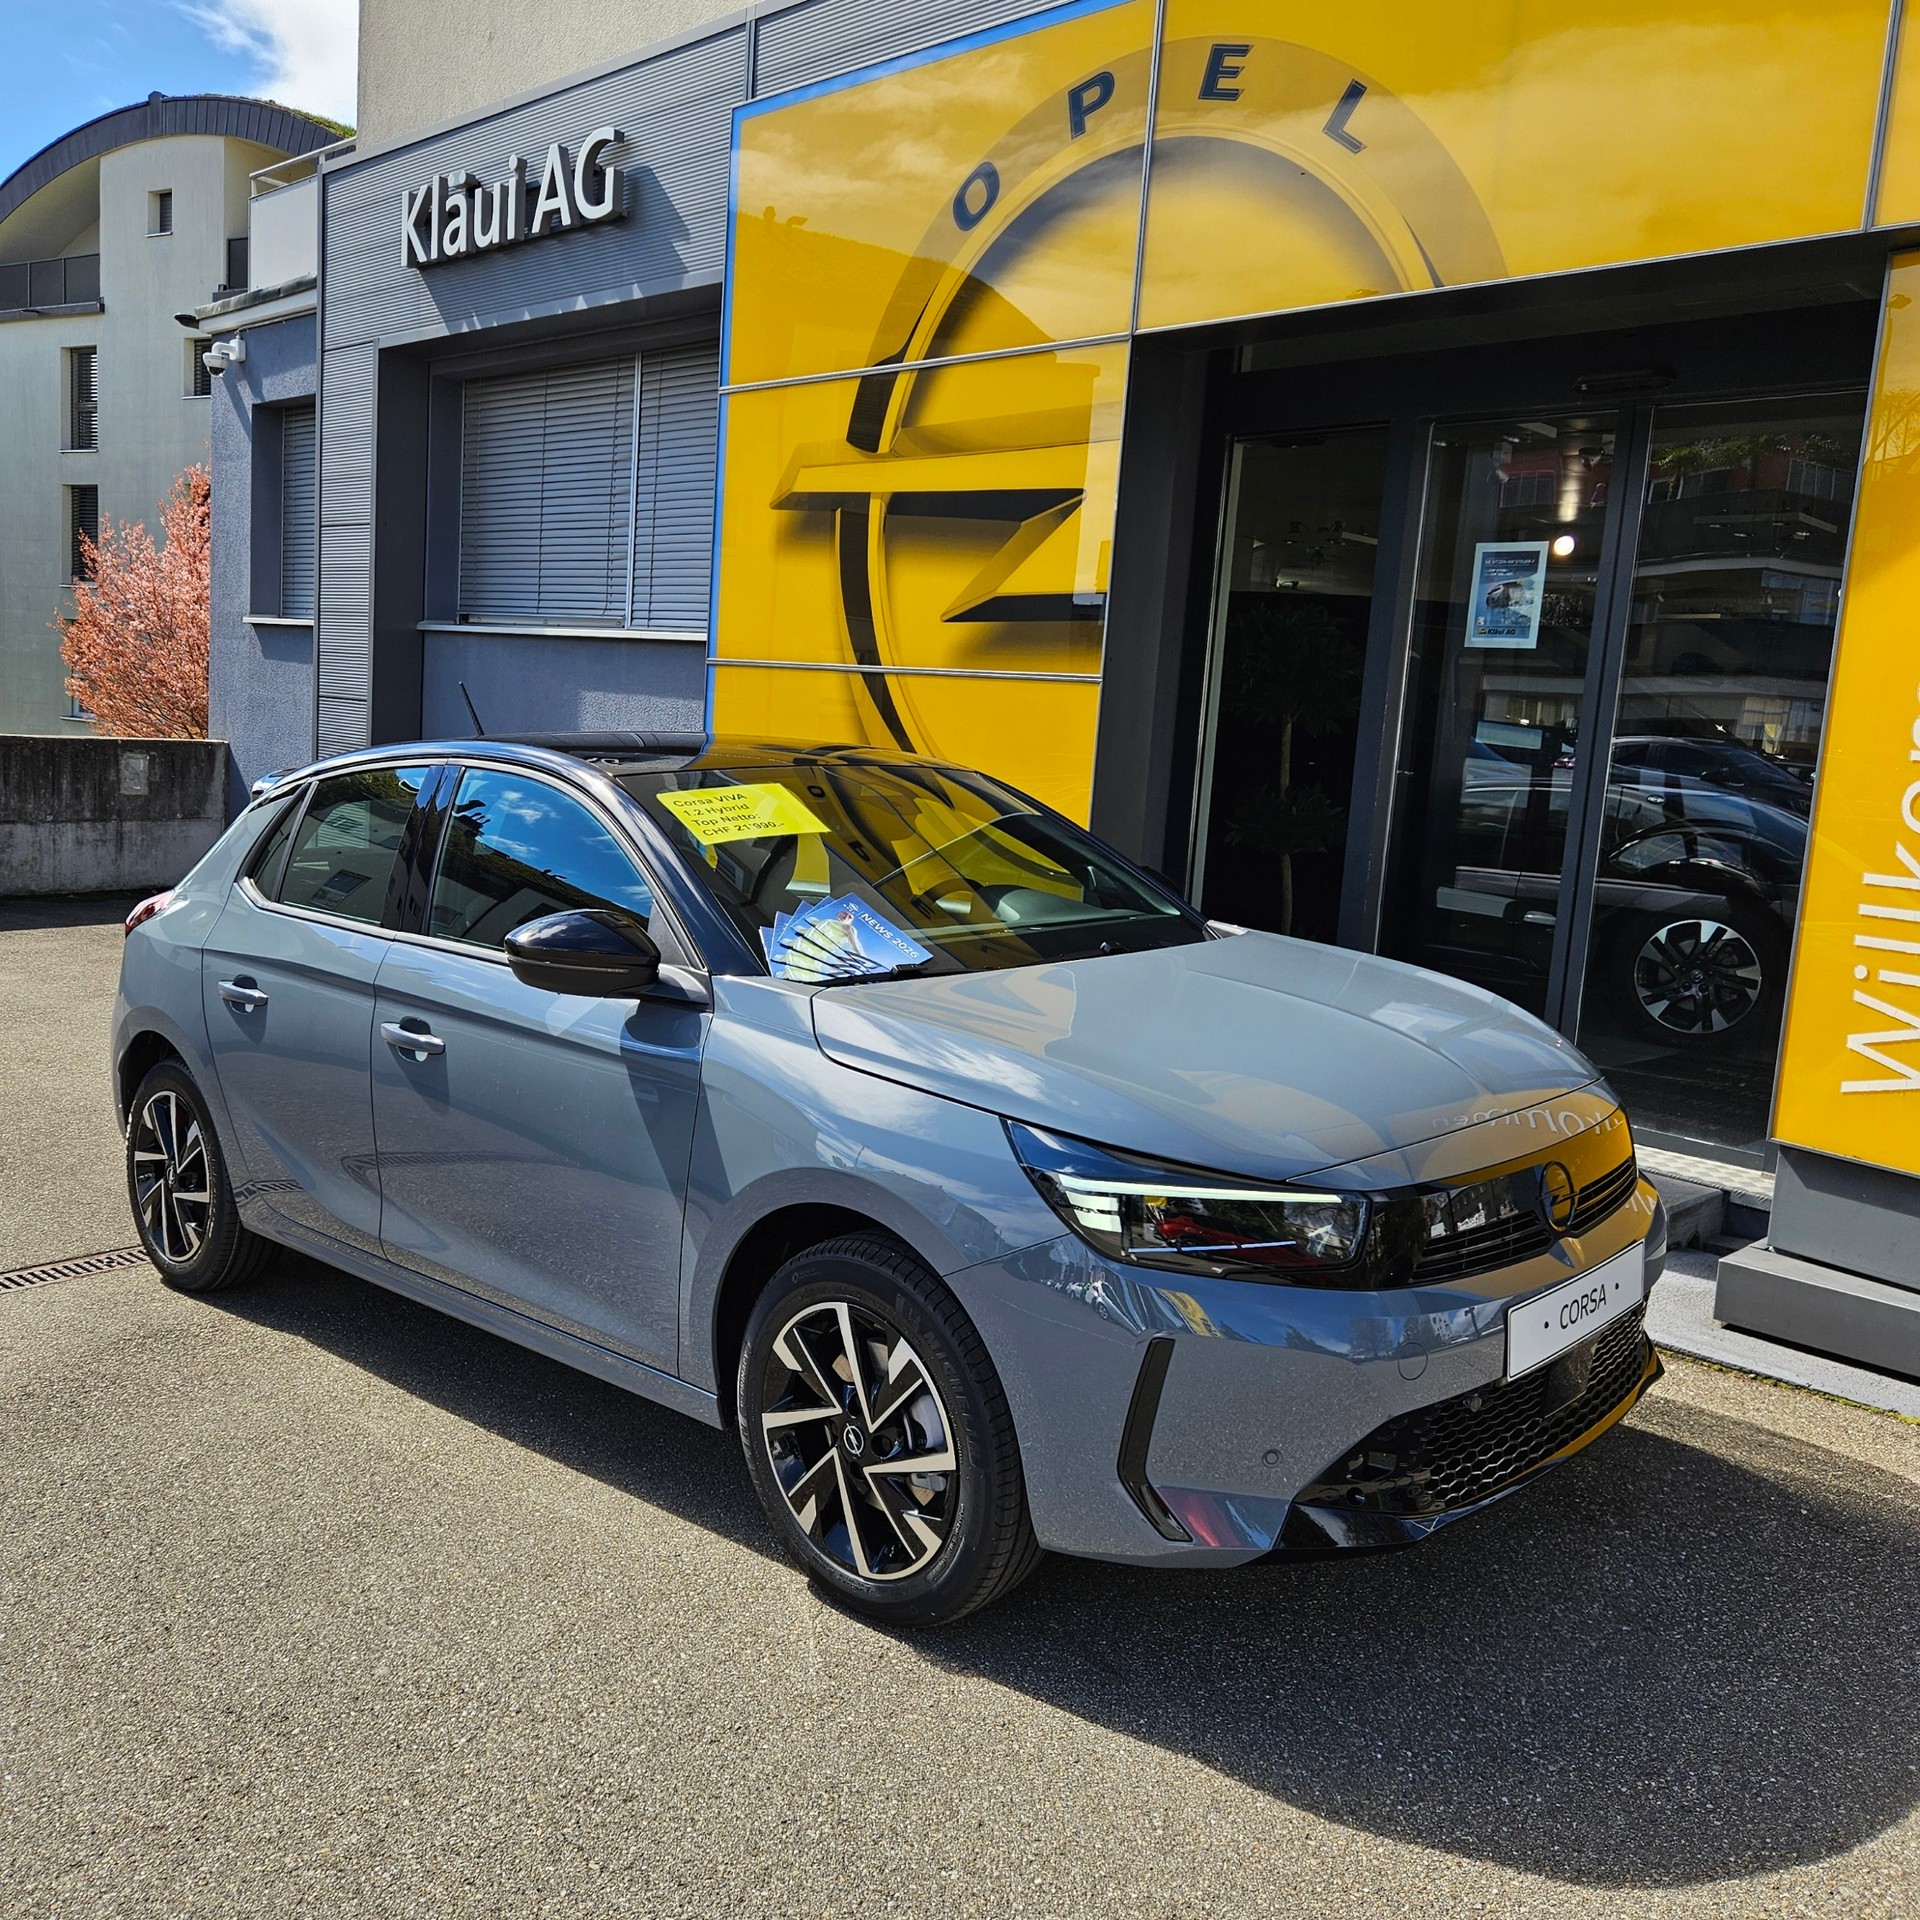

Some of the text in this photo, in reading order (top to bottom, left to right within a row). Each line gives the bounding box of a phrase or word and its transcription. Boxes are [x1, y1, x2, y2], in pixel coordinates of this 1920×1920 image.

[952, 43, 1368, 232] OPEL
[401, 126, 624, 267] Kläui AG
[673, 793, 747, 808] Corsa VIVA
[683, 803, 750, 817] 1.2 Hybrid
[691, 813, 761, 828] Top Netto:
[702, 826, 731, 837] CHF
[861, 913, 920, 958] NEWS 2026
[1559, 1283, 1607, 1330] CORSA
